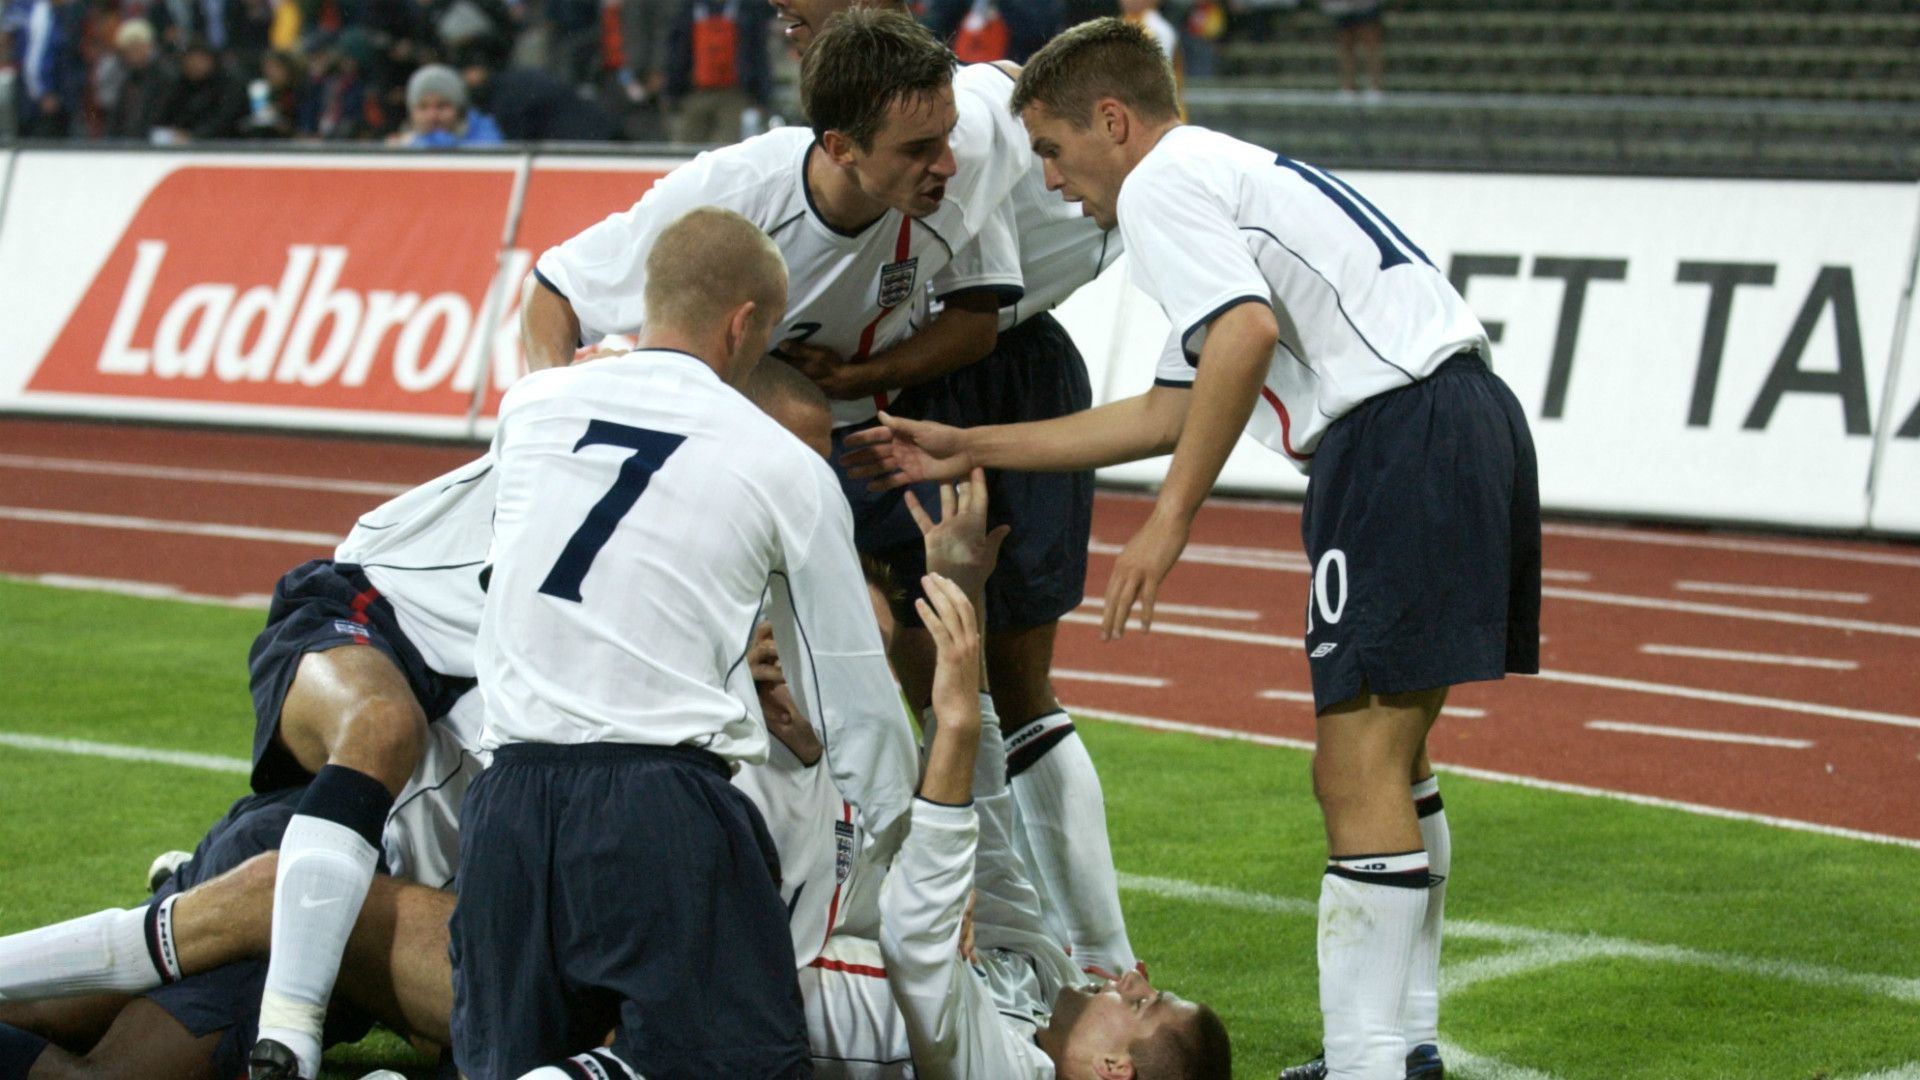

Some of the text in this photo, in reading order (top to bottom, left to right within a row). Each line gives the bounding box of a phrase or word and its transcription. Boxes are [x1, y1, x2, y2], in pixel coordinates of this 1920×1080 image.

[97, 240, 532, 392] Ladbrok
[1675, 260, 1920, 438] TA
[537, 418, 688, 604] 7
